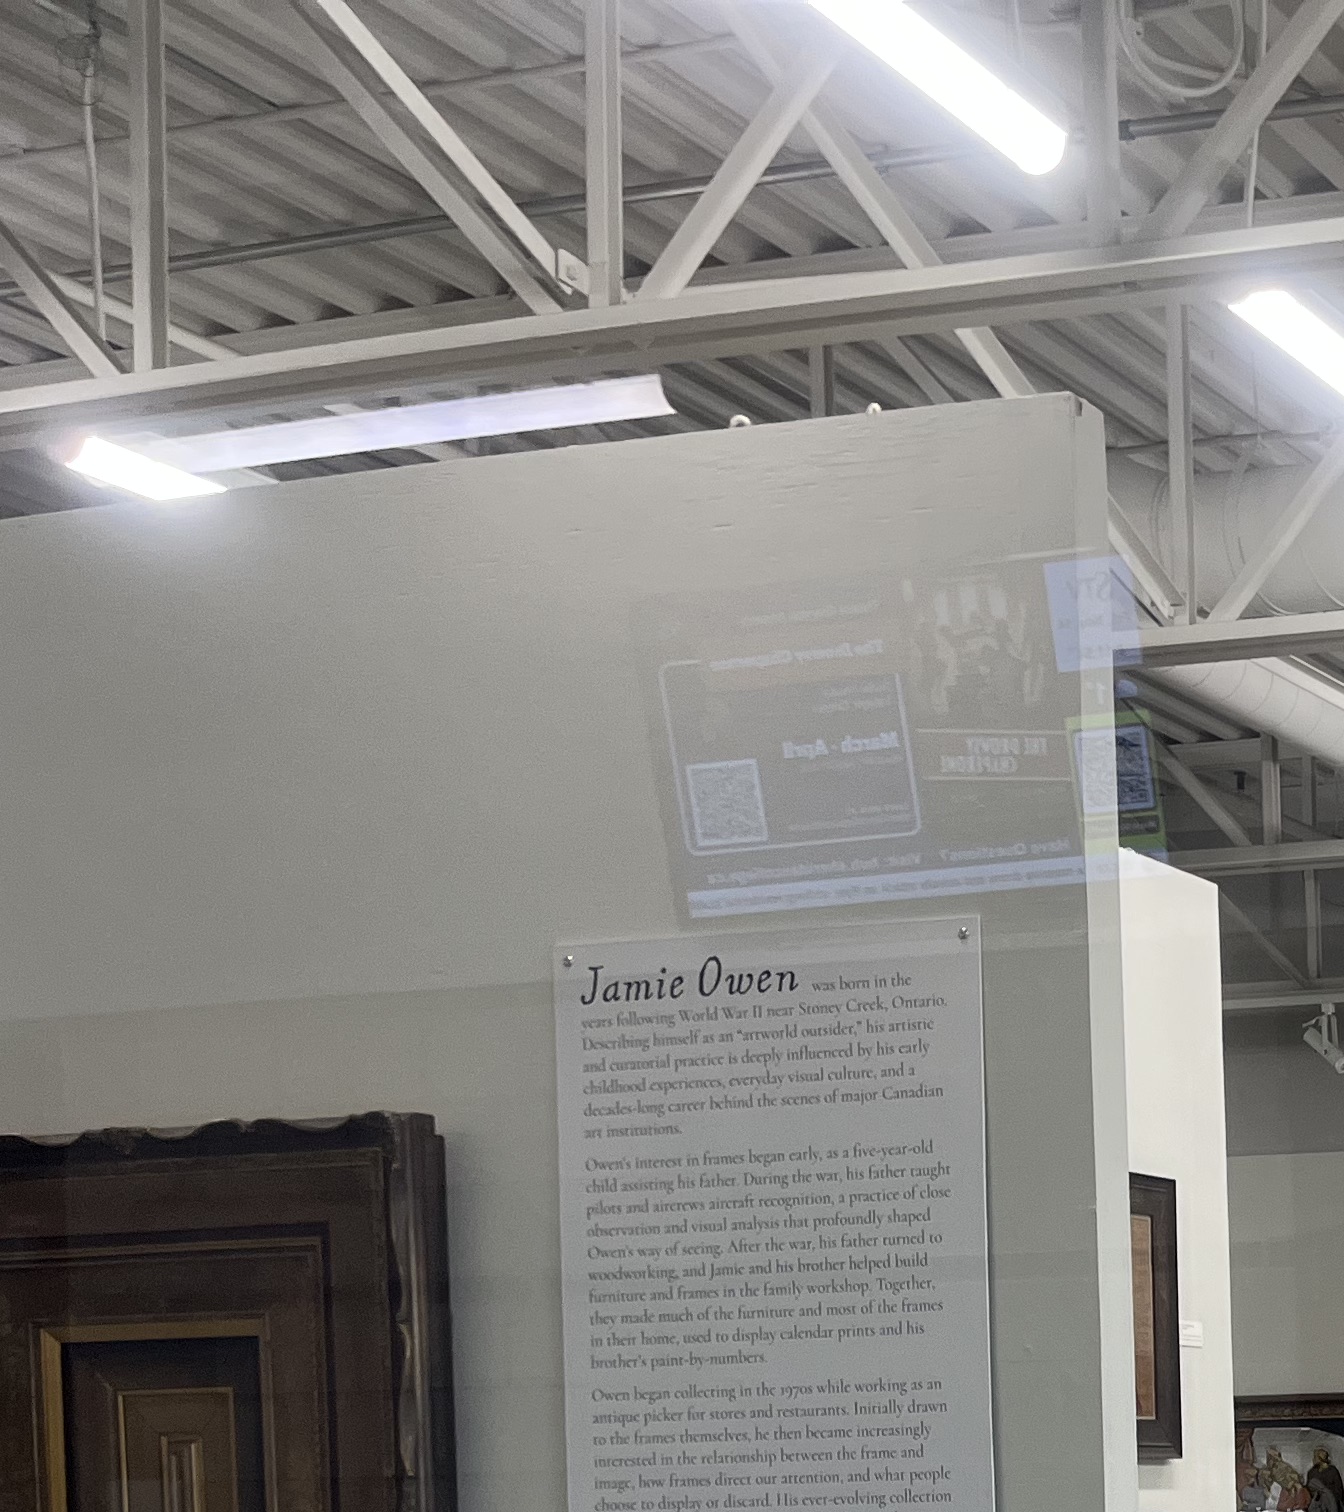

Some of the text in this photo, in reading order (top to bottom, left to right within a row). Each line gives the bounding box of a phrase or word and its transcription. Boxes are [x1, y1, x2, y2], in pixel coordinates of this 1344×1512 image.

[580, 954, 912, 1006] Jamie Owen was born in the
[678, 1006, 719, 1023] World
[721, 1004, 748, 1020] War
[751, 1003, 763, 1018] II
[766, 1005, 794, 1017] near
[797, 998, 841, 1019] Stoney
[865, 1015, 934, 1033] his artistic
[785, 1038, 930, 1062] influenced by his early
[822, 1083, 944, 1107] of major Canadian
[852, 1139, 934, 1161] five-year-old
[742, 1169, 789, 1190] During
[791, 1167, 812, 1183] the
[845, 1165, 865, 1181] his
[867, 1163, 906, 1179] father
[909, 1160, 951, 1181] taught
[848, 1186, 900, 1207] practice
[901, 1185, 916, 1200] of
[918, 1183, 951, 1199] close
[782, 1207, 932, 1231] that profoundly shaped
[817, 1229, 943, 1249] his father turned to
[774, 1252, 929, 1275] his brother helped build
[876, 1296, 944, 1314] the frames
[778, 1319, 925, 1342] calendar prints and his
[815, 1378, 851, 1394] while
[853, 1376, 907, 1397] working
[910, 1379, 924, 1391] as
[925, 1379, 942, 1390] an
[853, 1397, 948, 1419] Initially drawn
[804, 1420, 932, 1441] became increasingly
[779, 1442, 925, 1462] between the frame and
[846, 1464, 951, 1485] and what people
[776, 1487, 952, 1510] His ever-evolving collection
